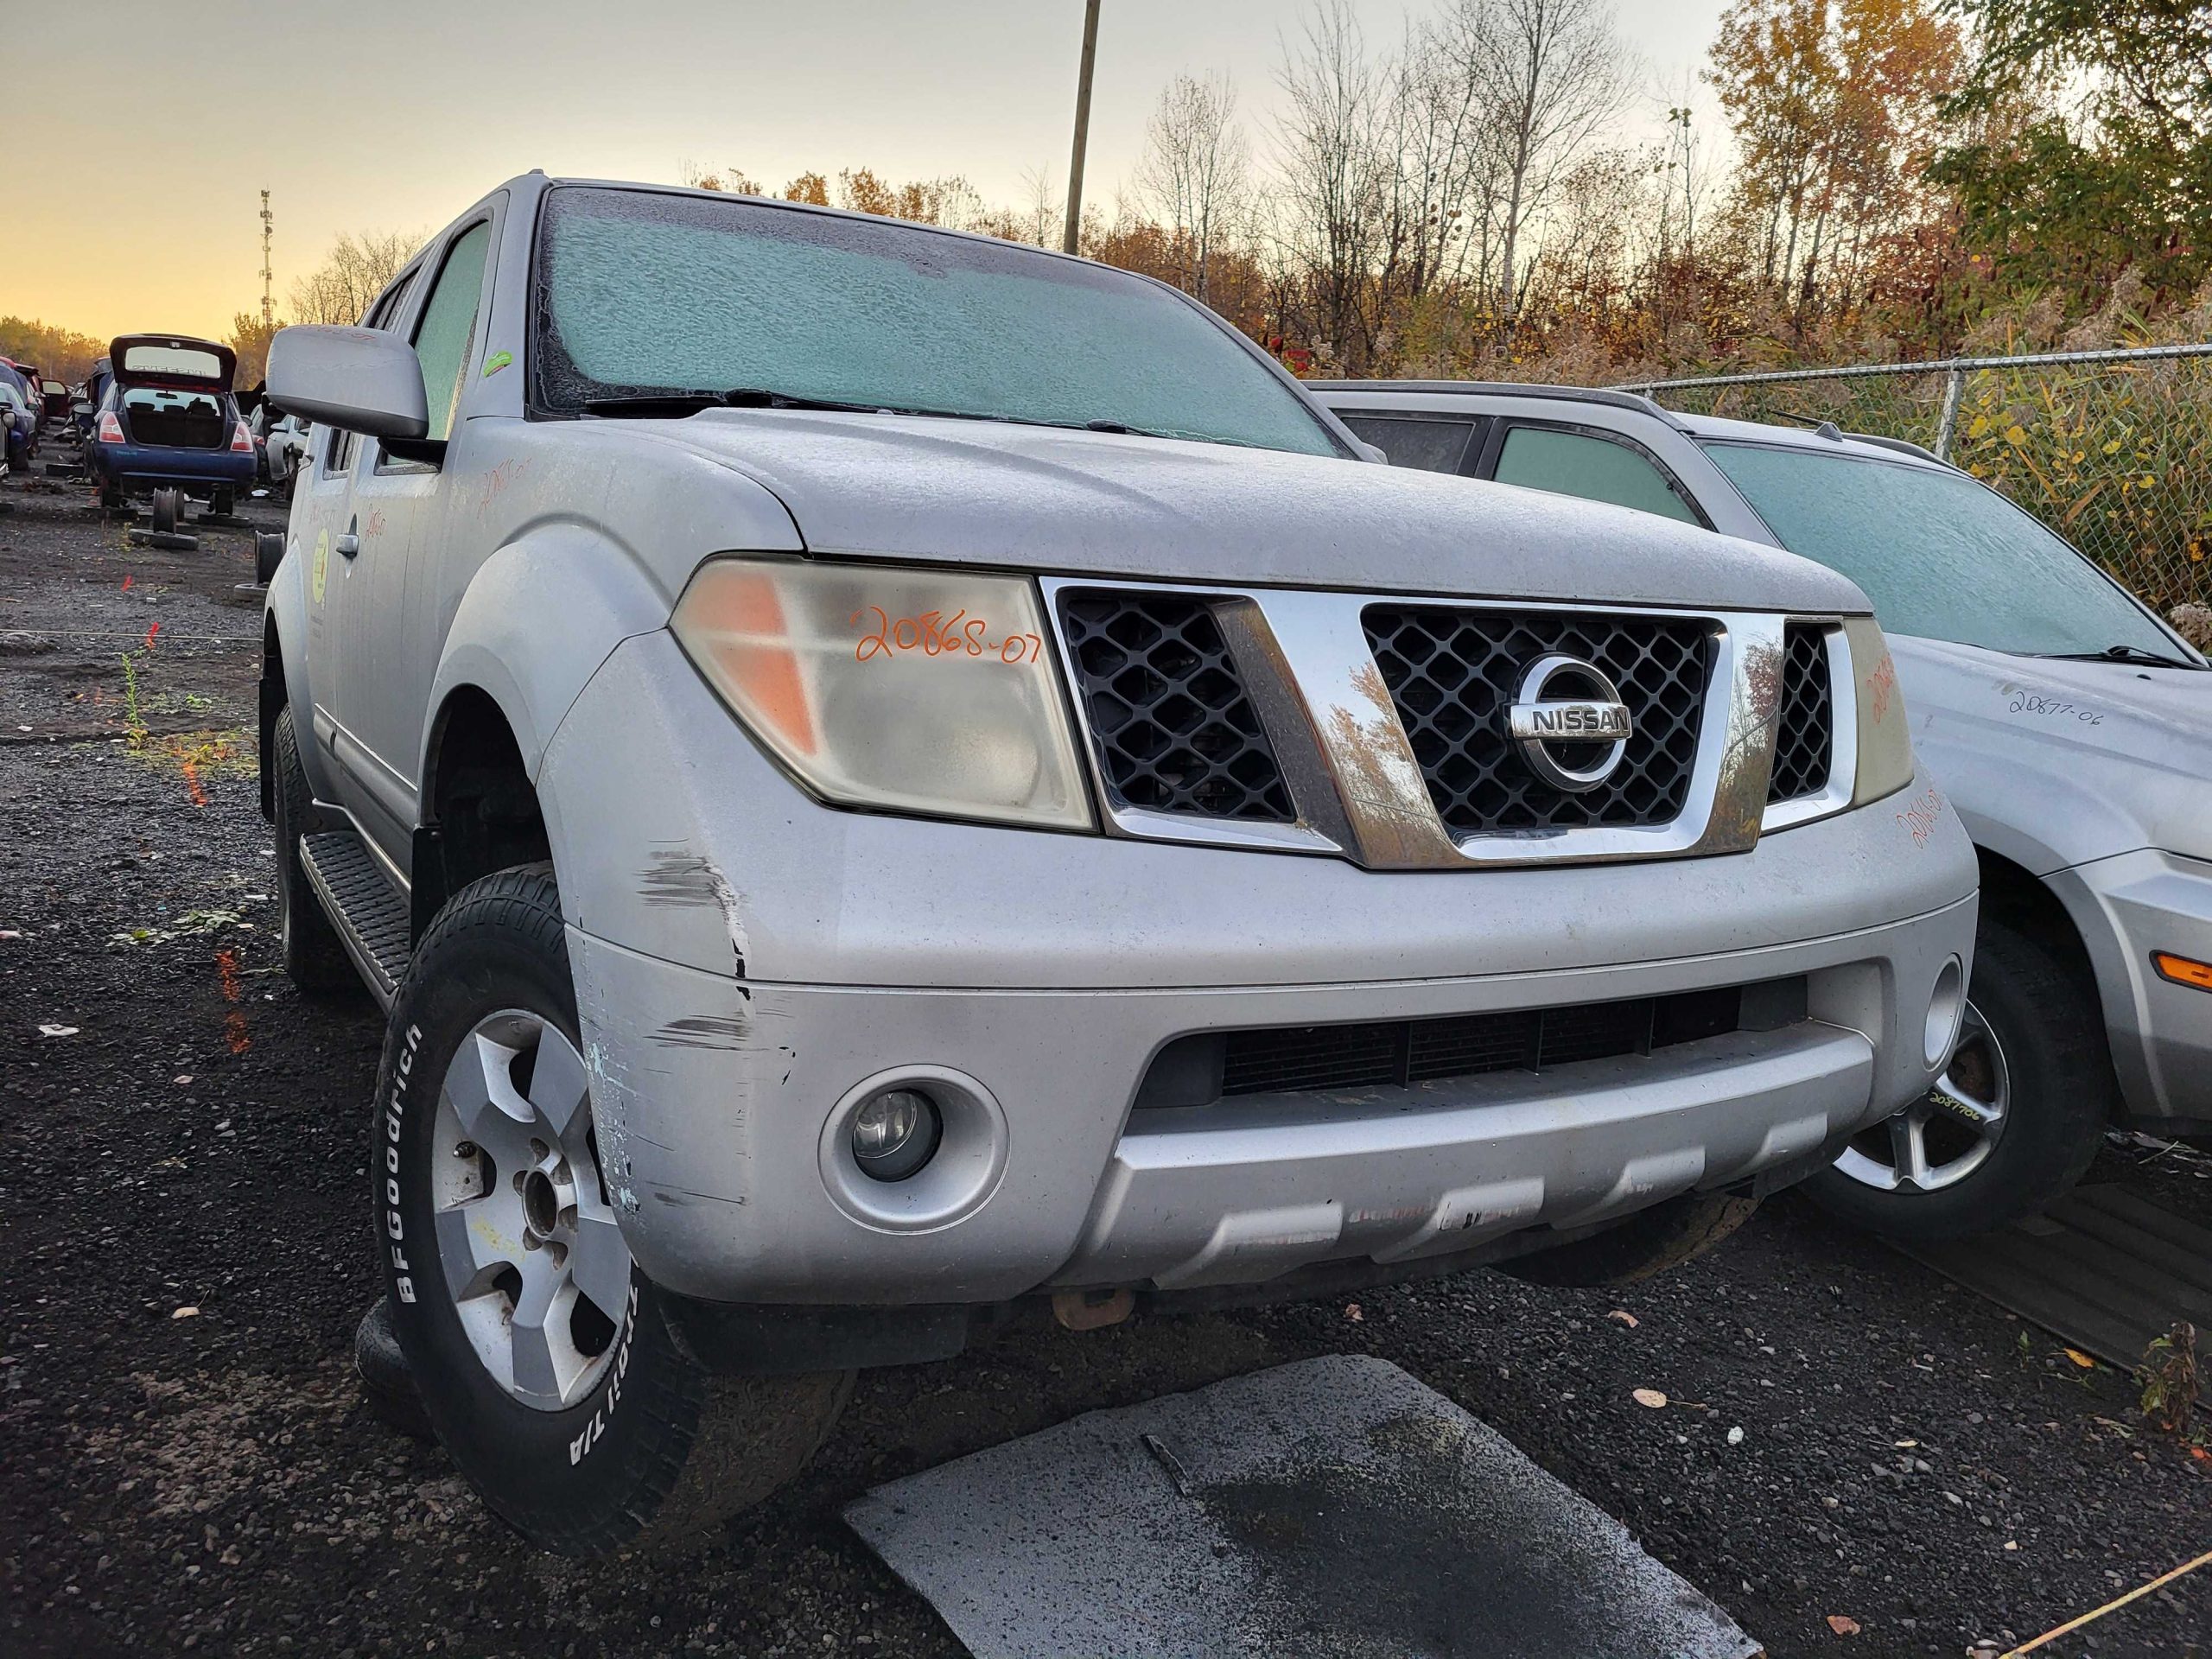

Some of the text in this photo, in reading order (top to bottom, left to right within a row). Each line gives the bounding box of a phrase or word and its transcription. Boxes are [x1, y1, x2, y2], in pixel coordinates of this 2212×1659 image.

[849, 606, 1041, 664] 20868-07
[1532, 710, 1629, 732] NISSAN
[2009, 690, 2104, 726] 20877-06
[386, 1023, 423, 1304] BFGoodrich
[569, 1408, 606, 1466] T/A
